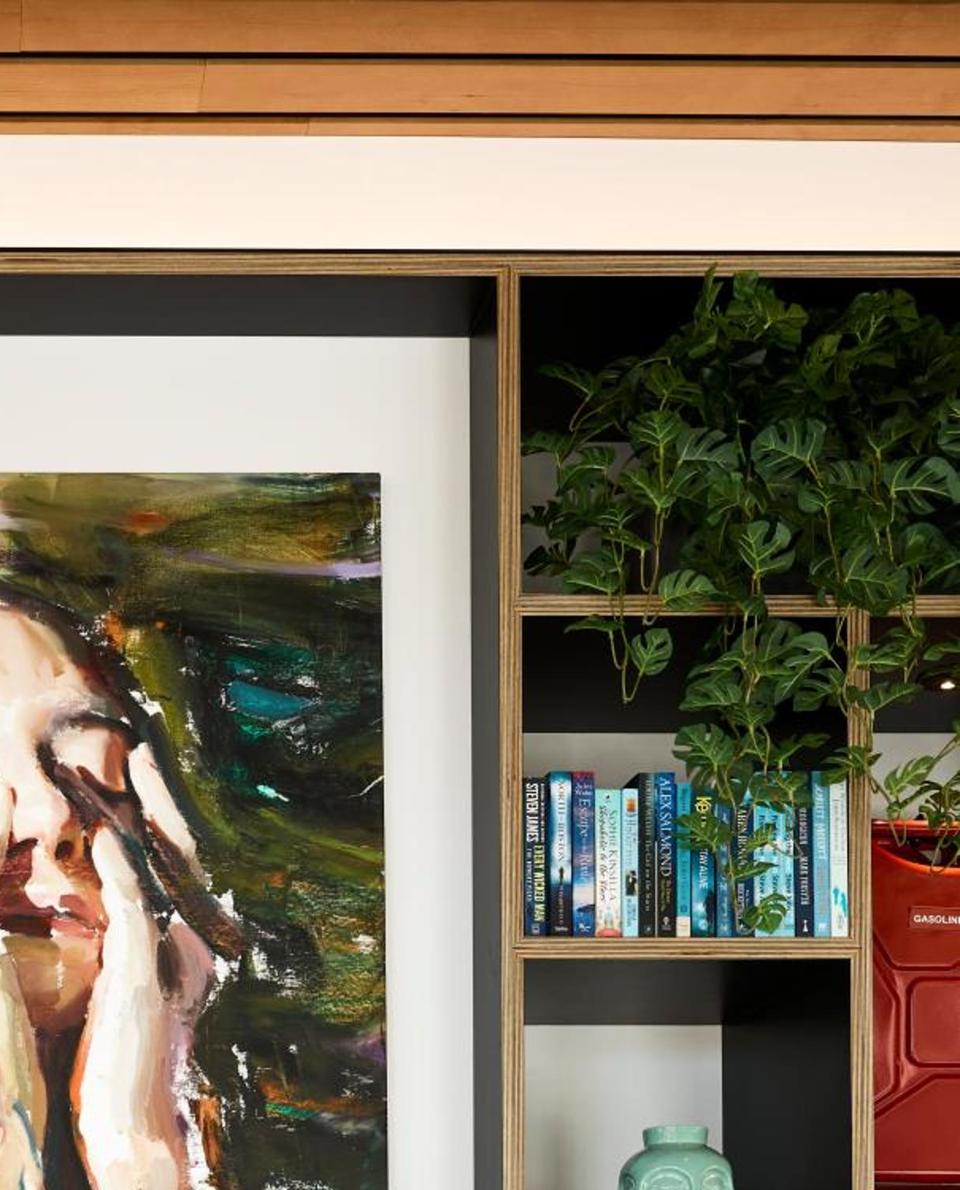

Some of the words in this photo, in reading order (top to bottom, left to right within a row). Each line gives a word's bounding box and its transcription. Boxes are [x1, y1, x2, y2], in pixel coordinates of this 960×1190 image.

[525, 783, 539, 813] STEVEN
[659, 777, 672, 810] ALEX
[525, 815, 539, 842] JAMES
[659, 811, 672, 877] SALMOND
